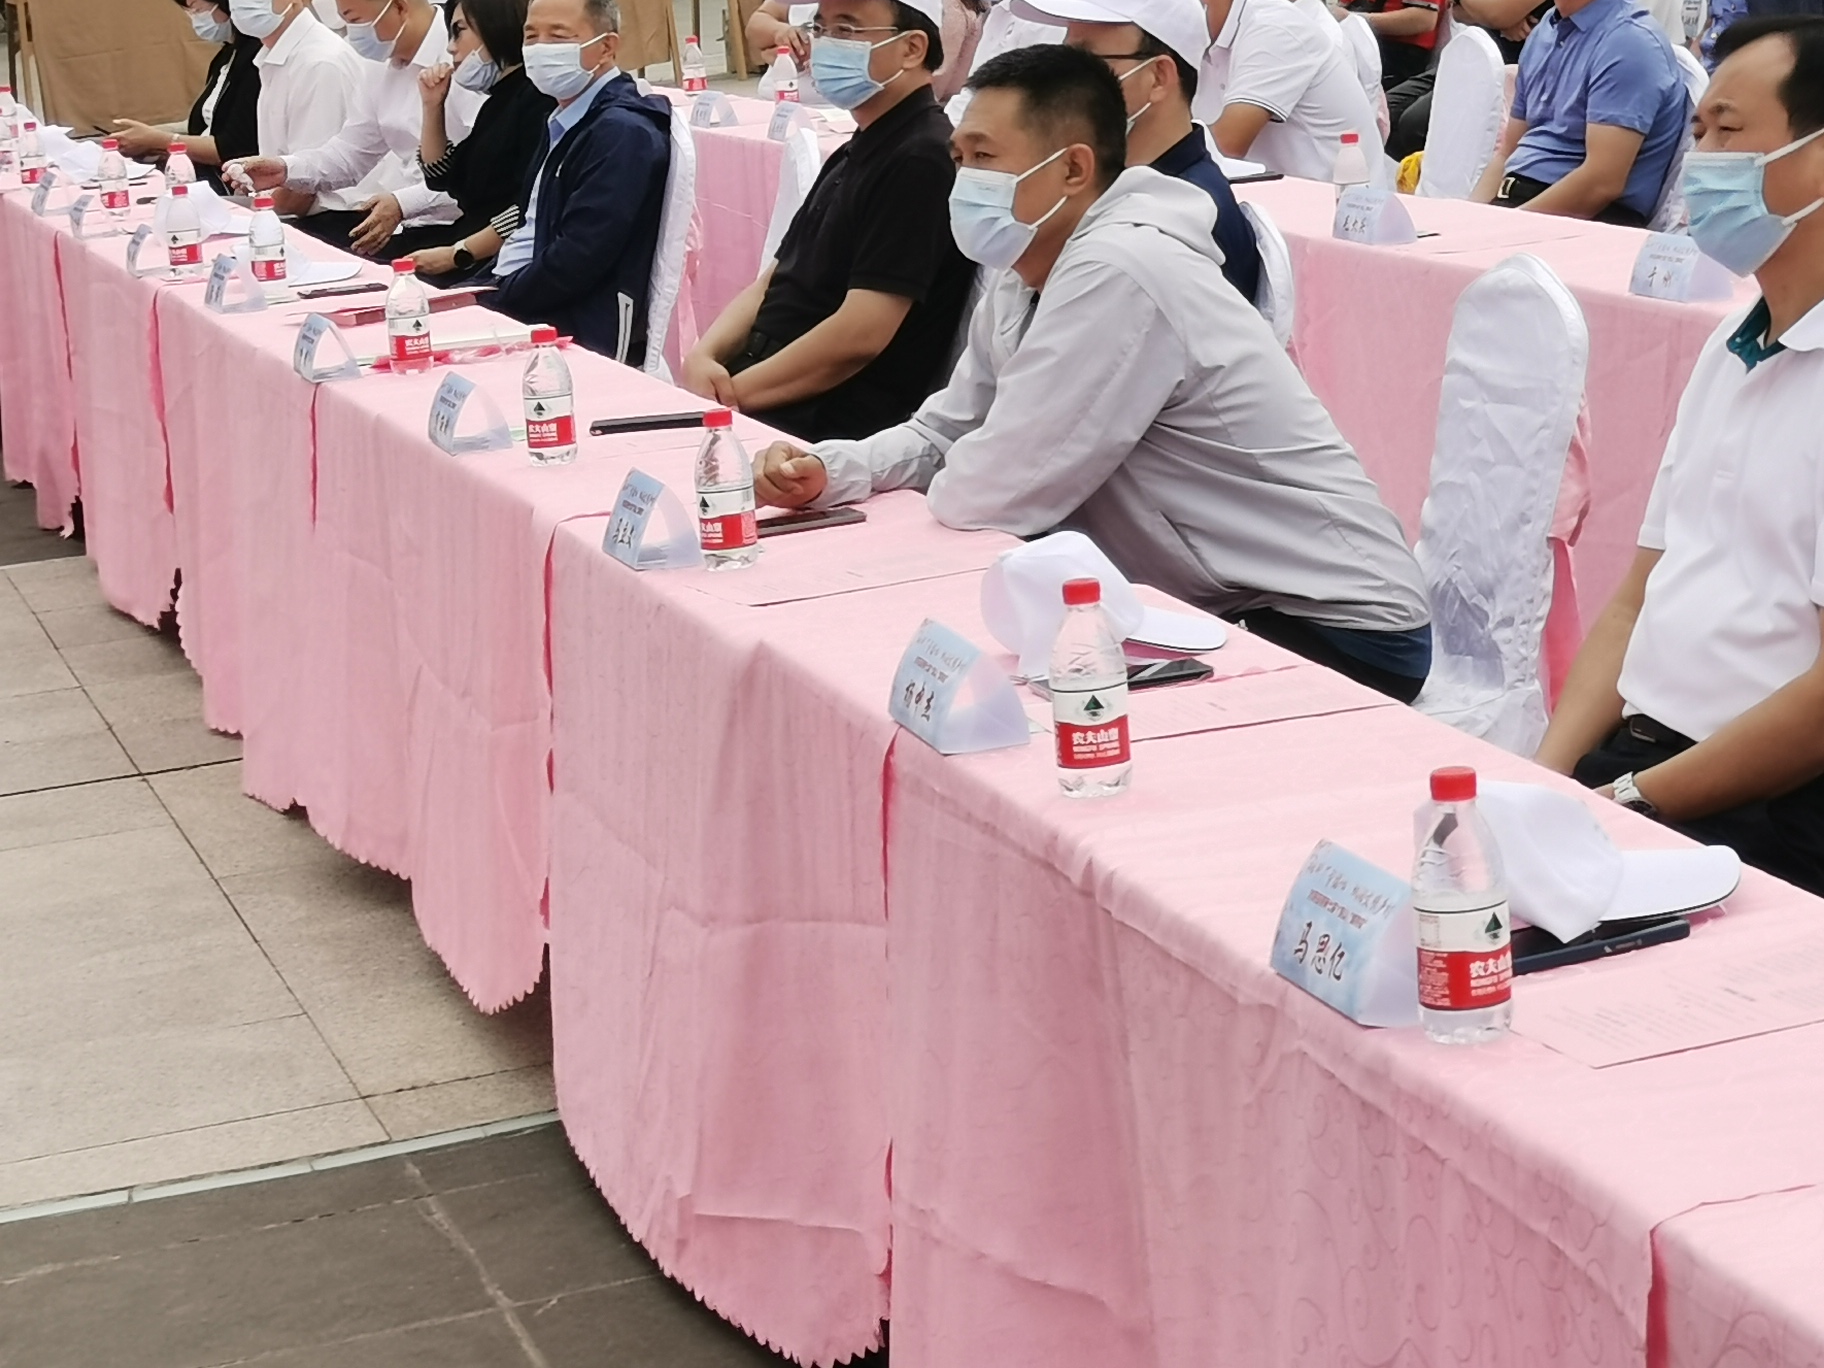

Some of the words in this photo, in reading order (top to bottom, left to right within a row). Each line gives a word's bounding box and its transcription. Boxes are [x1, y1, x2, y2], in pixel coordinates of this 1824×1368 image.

[1071, 727, 1119, 746] 农夫山泉
[1293, 920, 1346, 982] 马思亿
